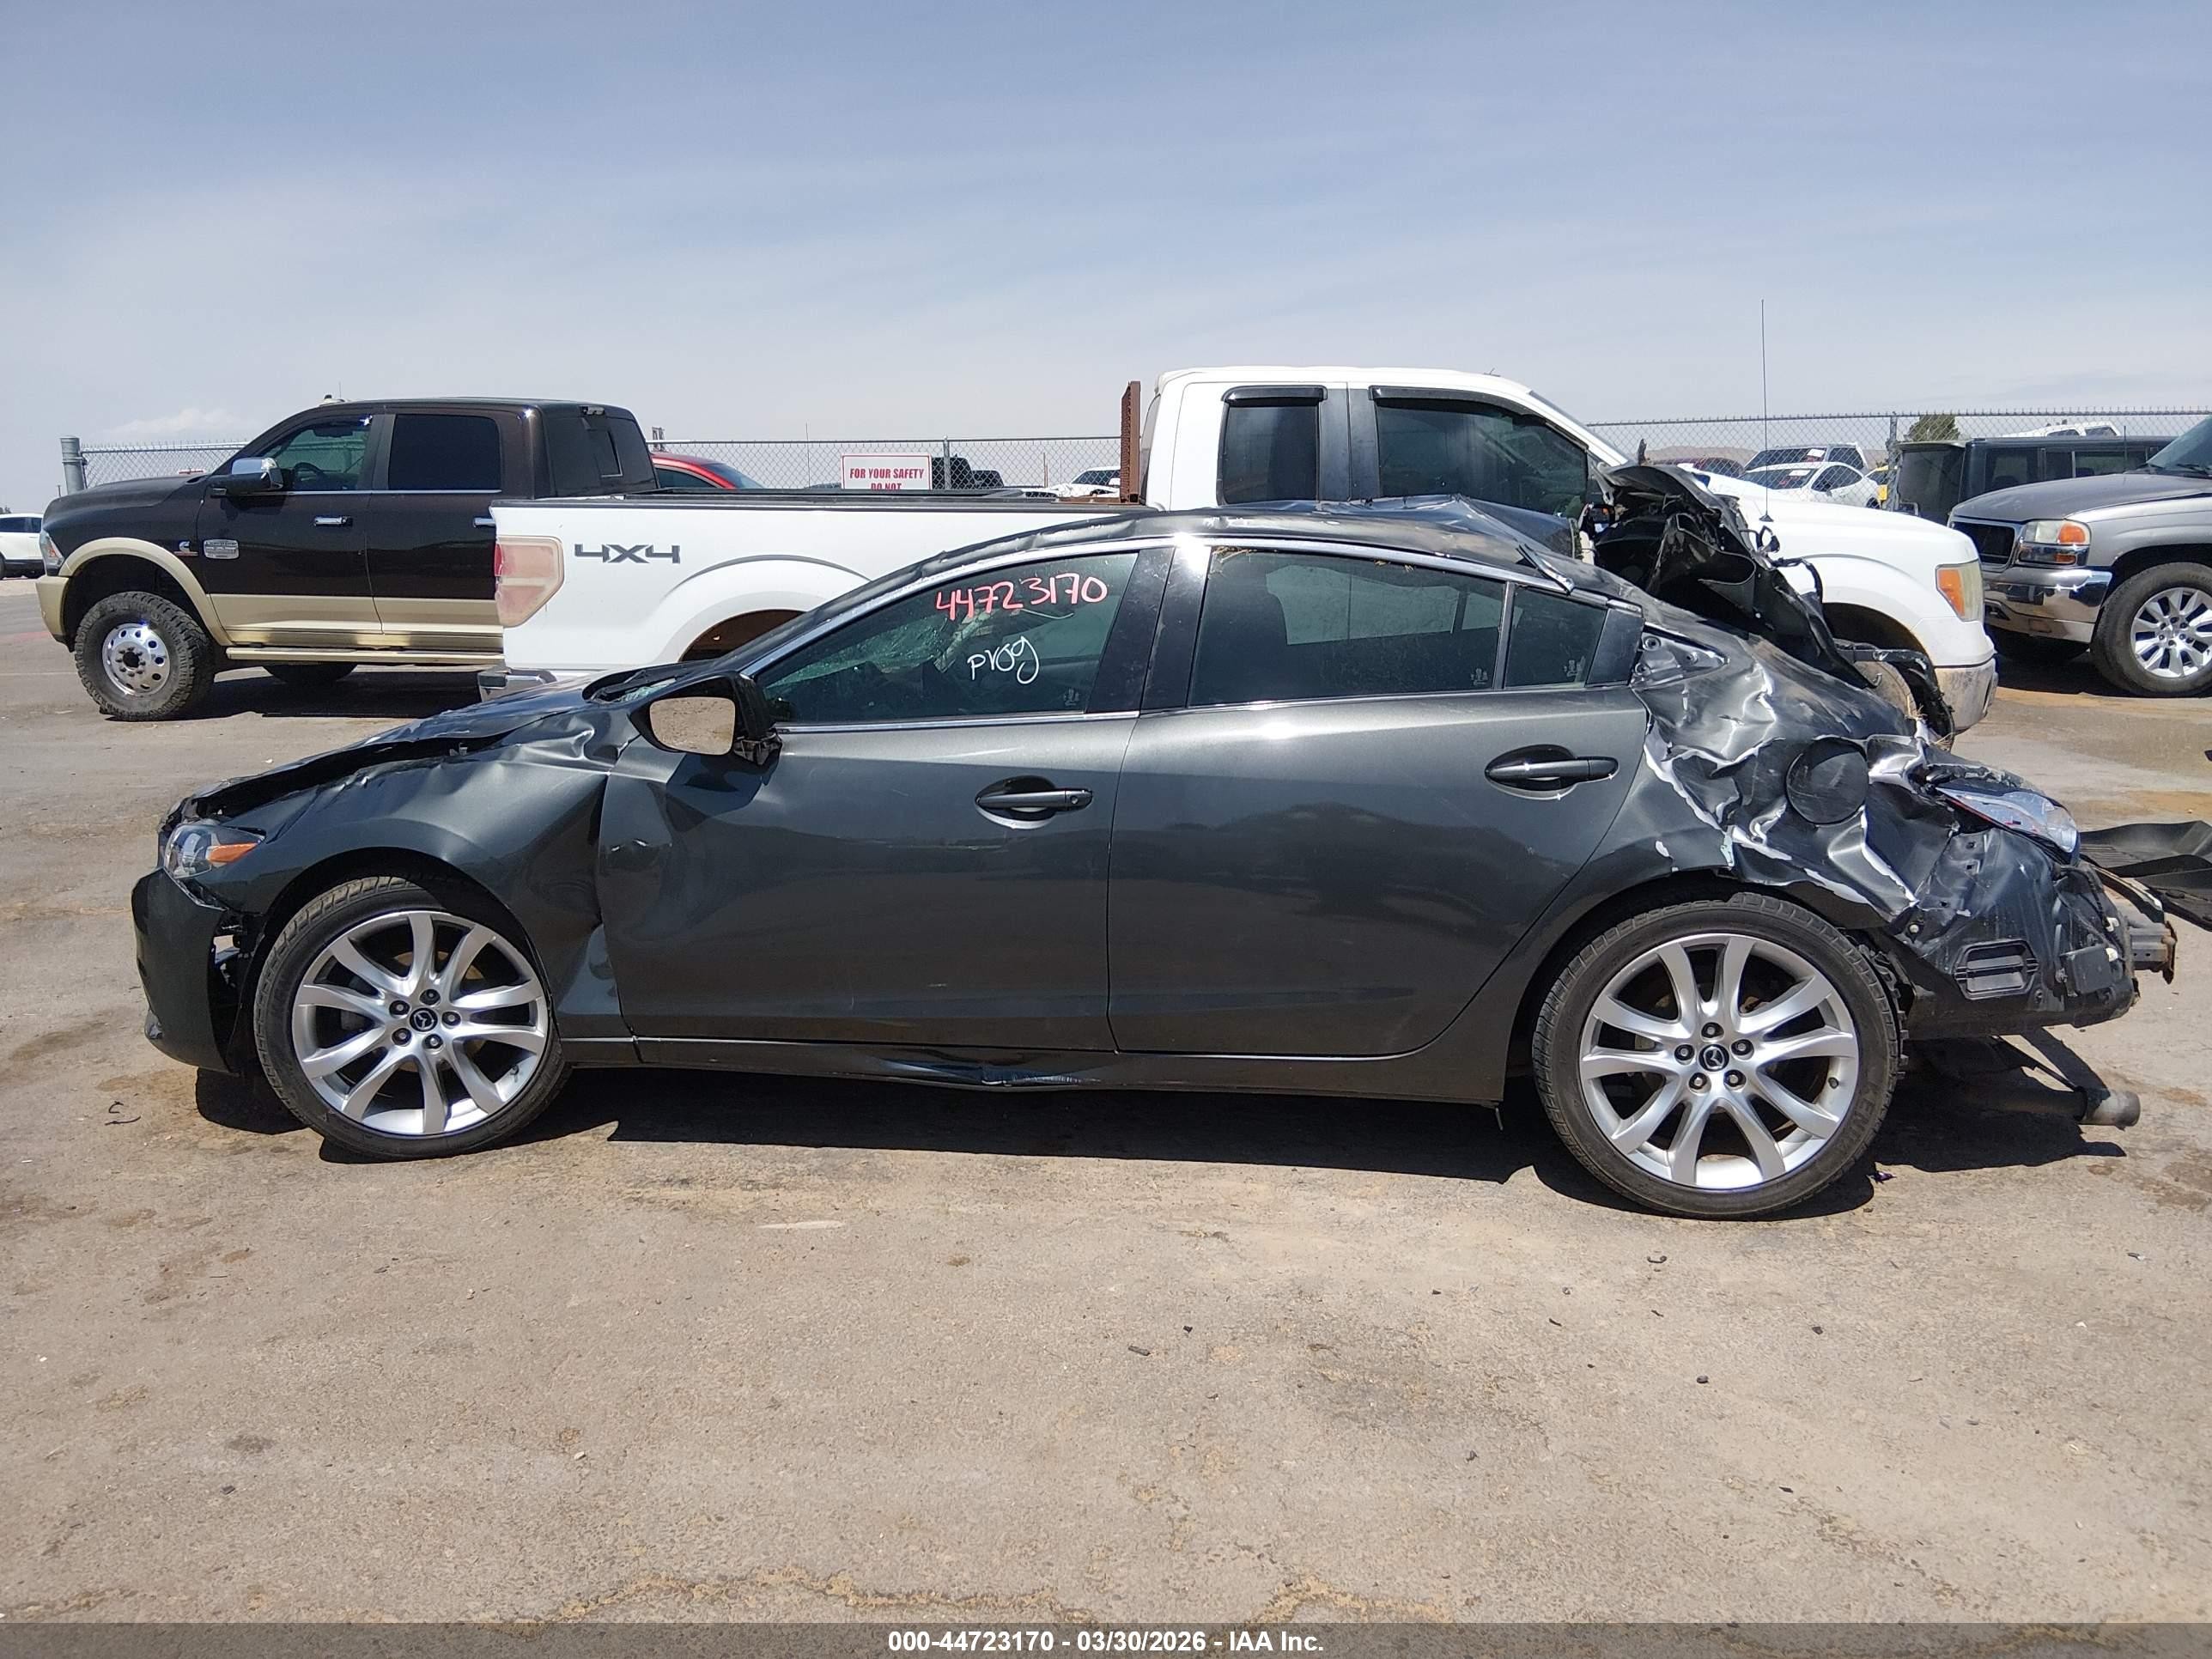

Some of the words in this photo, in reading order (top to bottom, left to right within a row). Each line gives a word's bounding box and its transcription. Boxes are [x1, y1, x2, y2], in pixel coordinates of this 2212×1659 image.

[850, 468, 866, 478] FOR
[868, 468, 891, 478] YOUR
[893, 468, 925, 478] SAFETY
[935, 573, 1109, 621] 44723170
